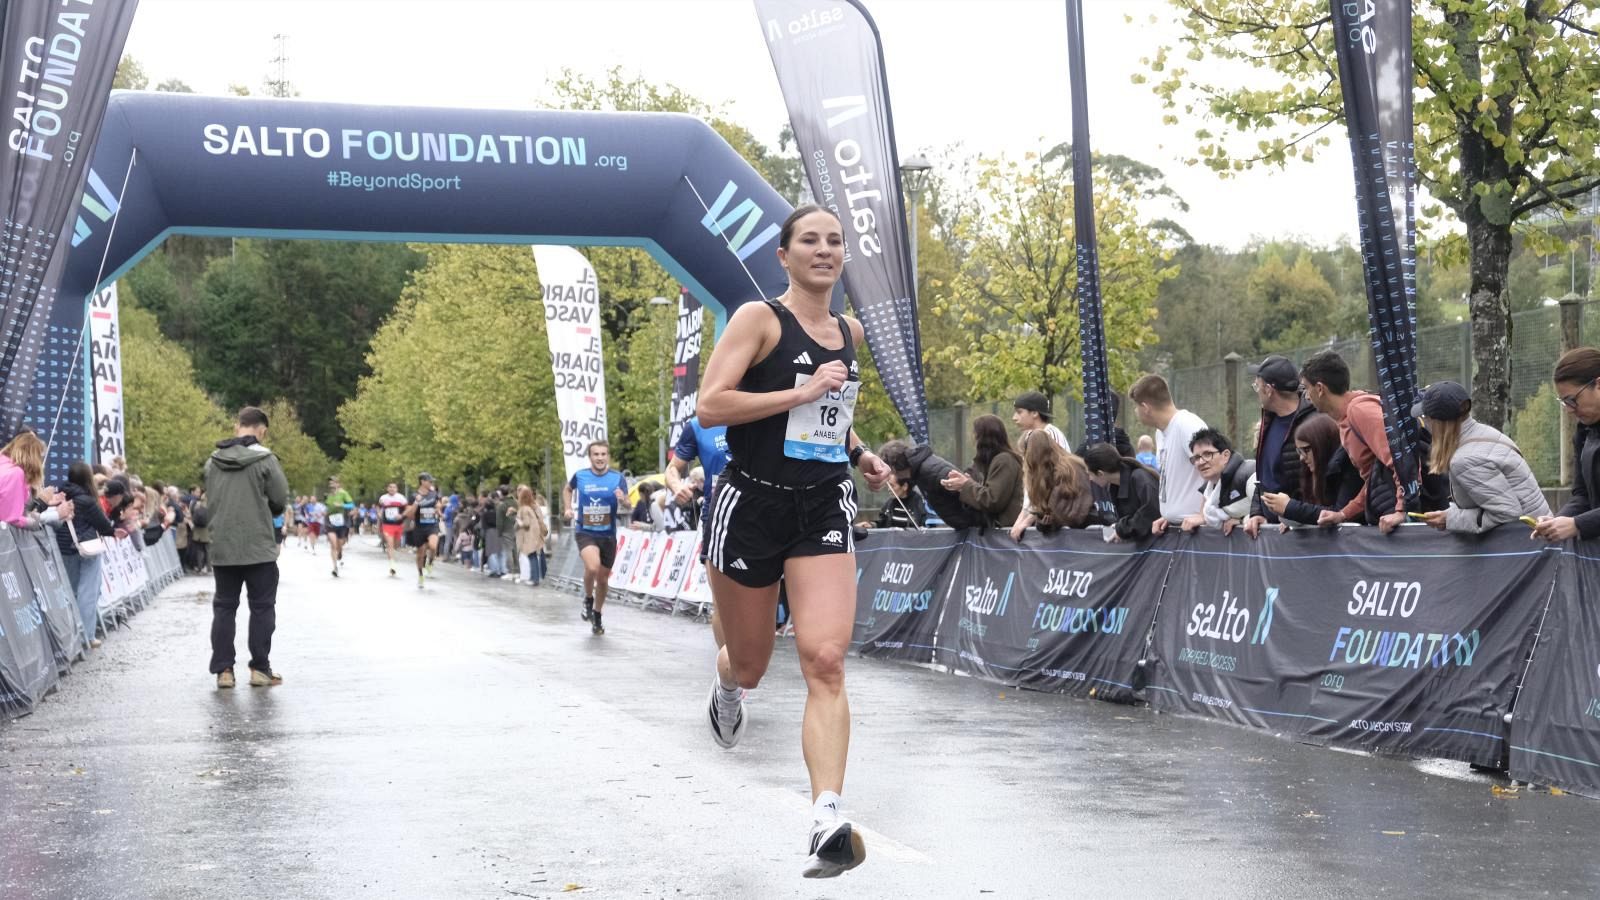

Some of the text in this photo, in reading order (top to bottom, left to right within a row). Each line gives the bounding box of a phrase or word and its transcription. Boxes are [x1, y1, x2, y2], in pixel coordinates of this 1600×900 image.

[203, 123, 628, 171] SALTO FOUNDATION .org
[326, 170, 462, 193] #BeyondSport
[820, 405, 839, 427] 18
[881, 561, 914, 585] SALTO
[1043, 568, 1093, 598] SALTO
[1347, 580, 1421, 618] SALTO
[1186, 590, 1250, 643] salto
[1320, 672, 1345, 693] .org
